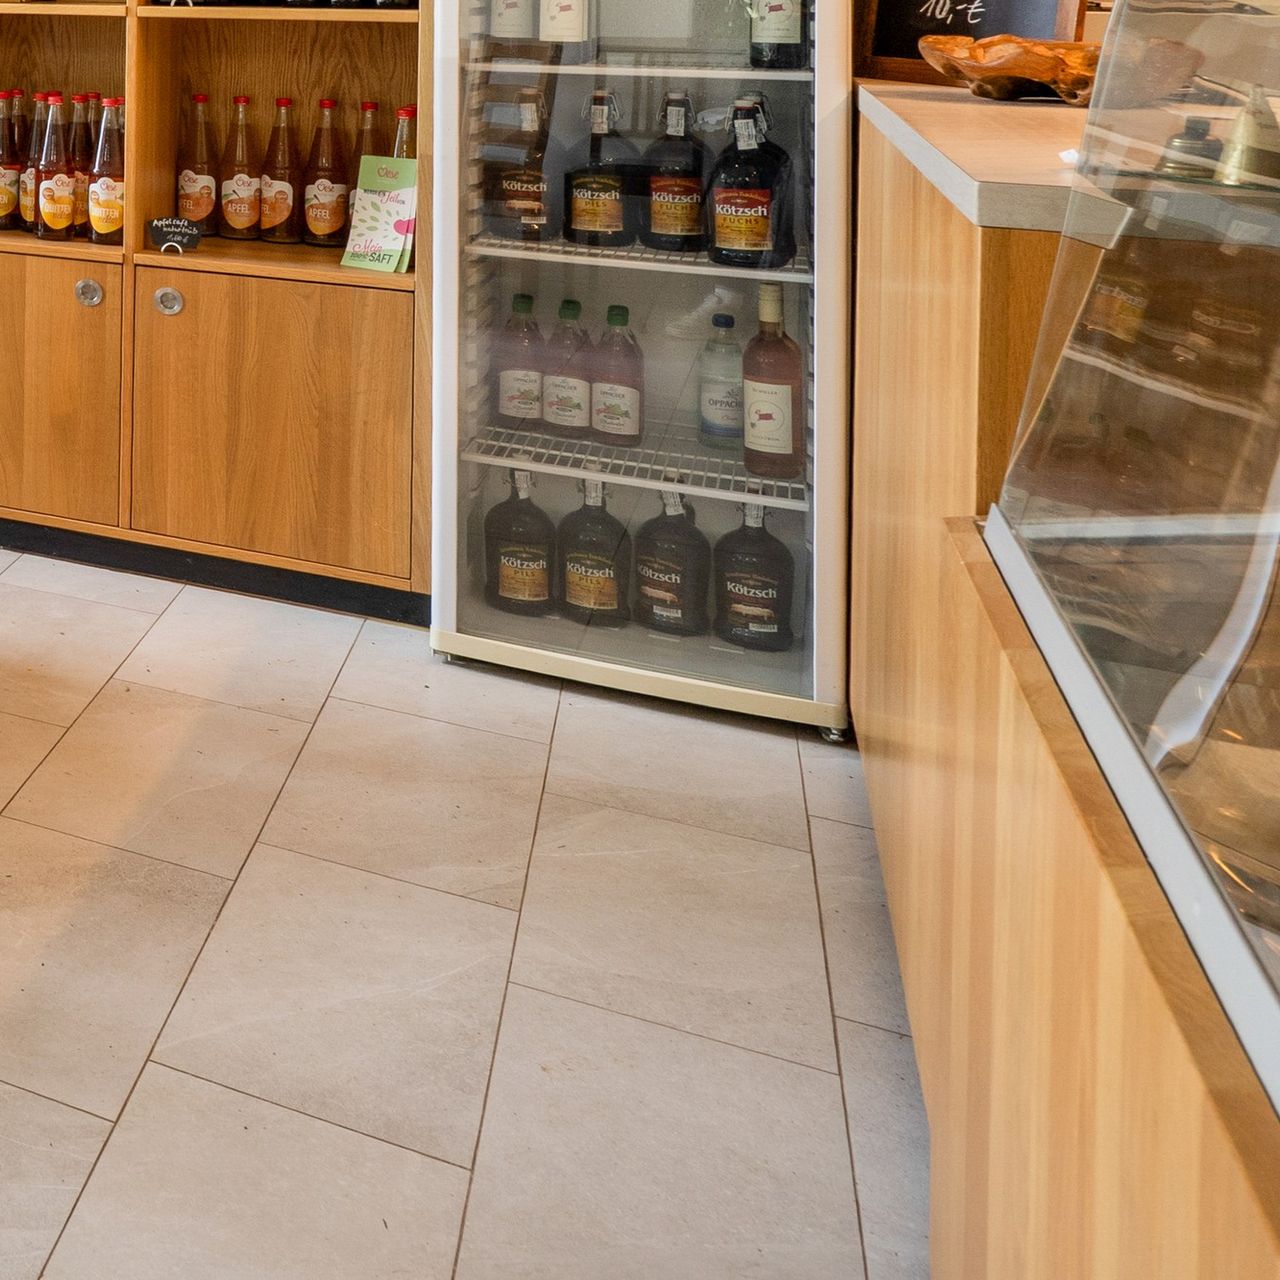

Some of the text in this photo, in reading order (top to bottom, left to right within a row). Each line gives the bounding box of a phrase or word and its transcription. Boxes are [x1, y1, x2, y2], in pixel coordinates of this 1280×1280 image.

[502, 179, 548, 192] Kötzsch
[572, 188, 620, 200] Kötzsch
[652, 191, 701, 203] Kötzsch
[227, 203, 250, 214] APFEL
[584, 200, 608, 208] PILS
[660, 203, 695, 212] FUCHS
[309, 207, 330, 219] APFEL
[715, 204, 768, 217] Kötzsch
[722, 217, 760, 225] FUCHS
[352, 239, 384, 253] Mein
[369, 251, 393, 265] SAFT
[708, 398, 744, 409] OPPACH
[501, 555, 547, 569] Kötzsch
[513, 569, 536, 577] PILS
[566, 561, 614, 578] Kötzsch
[726, 581, 777, 599] Kötzsch
